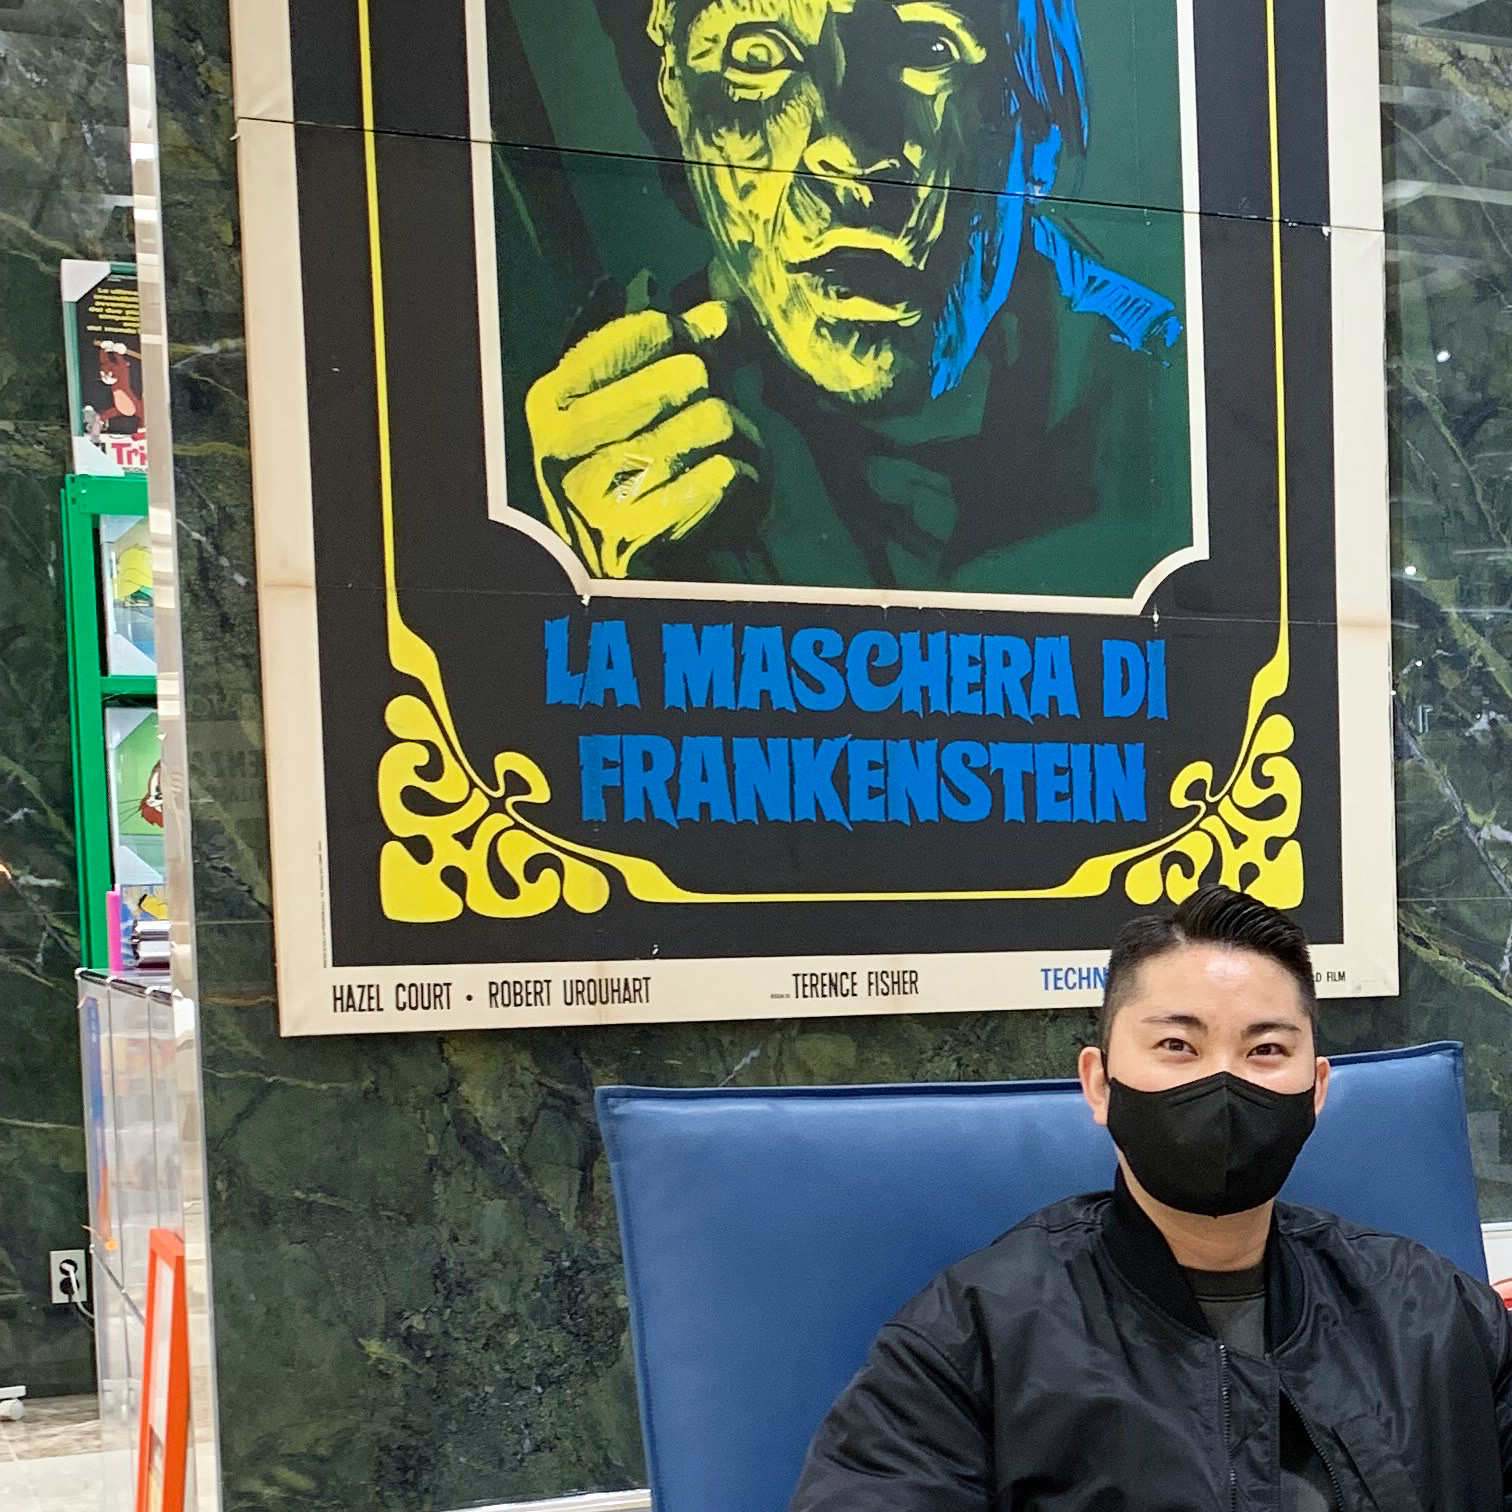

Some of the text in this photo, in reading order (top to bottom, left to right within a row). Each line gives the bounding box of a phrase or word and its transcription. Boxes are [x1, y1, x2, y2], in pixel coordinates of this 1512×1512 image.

[544, 614, 1169, 725] LA MASCHERA DI
[578, 733, 1148, 832] FRANKENSTEIN
[791, 970, 919, 999] TERENCE FISHER
[1326, 970, 1346, 982] FILM
[332, 982, 453, 1013] HAZEL COURT
[488, 979, 552, 1009] ROBERT
